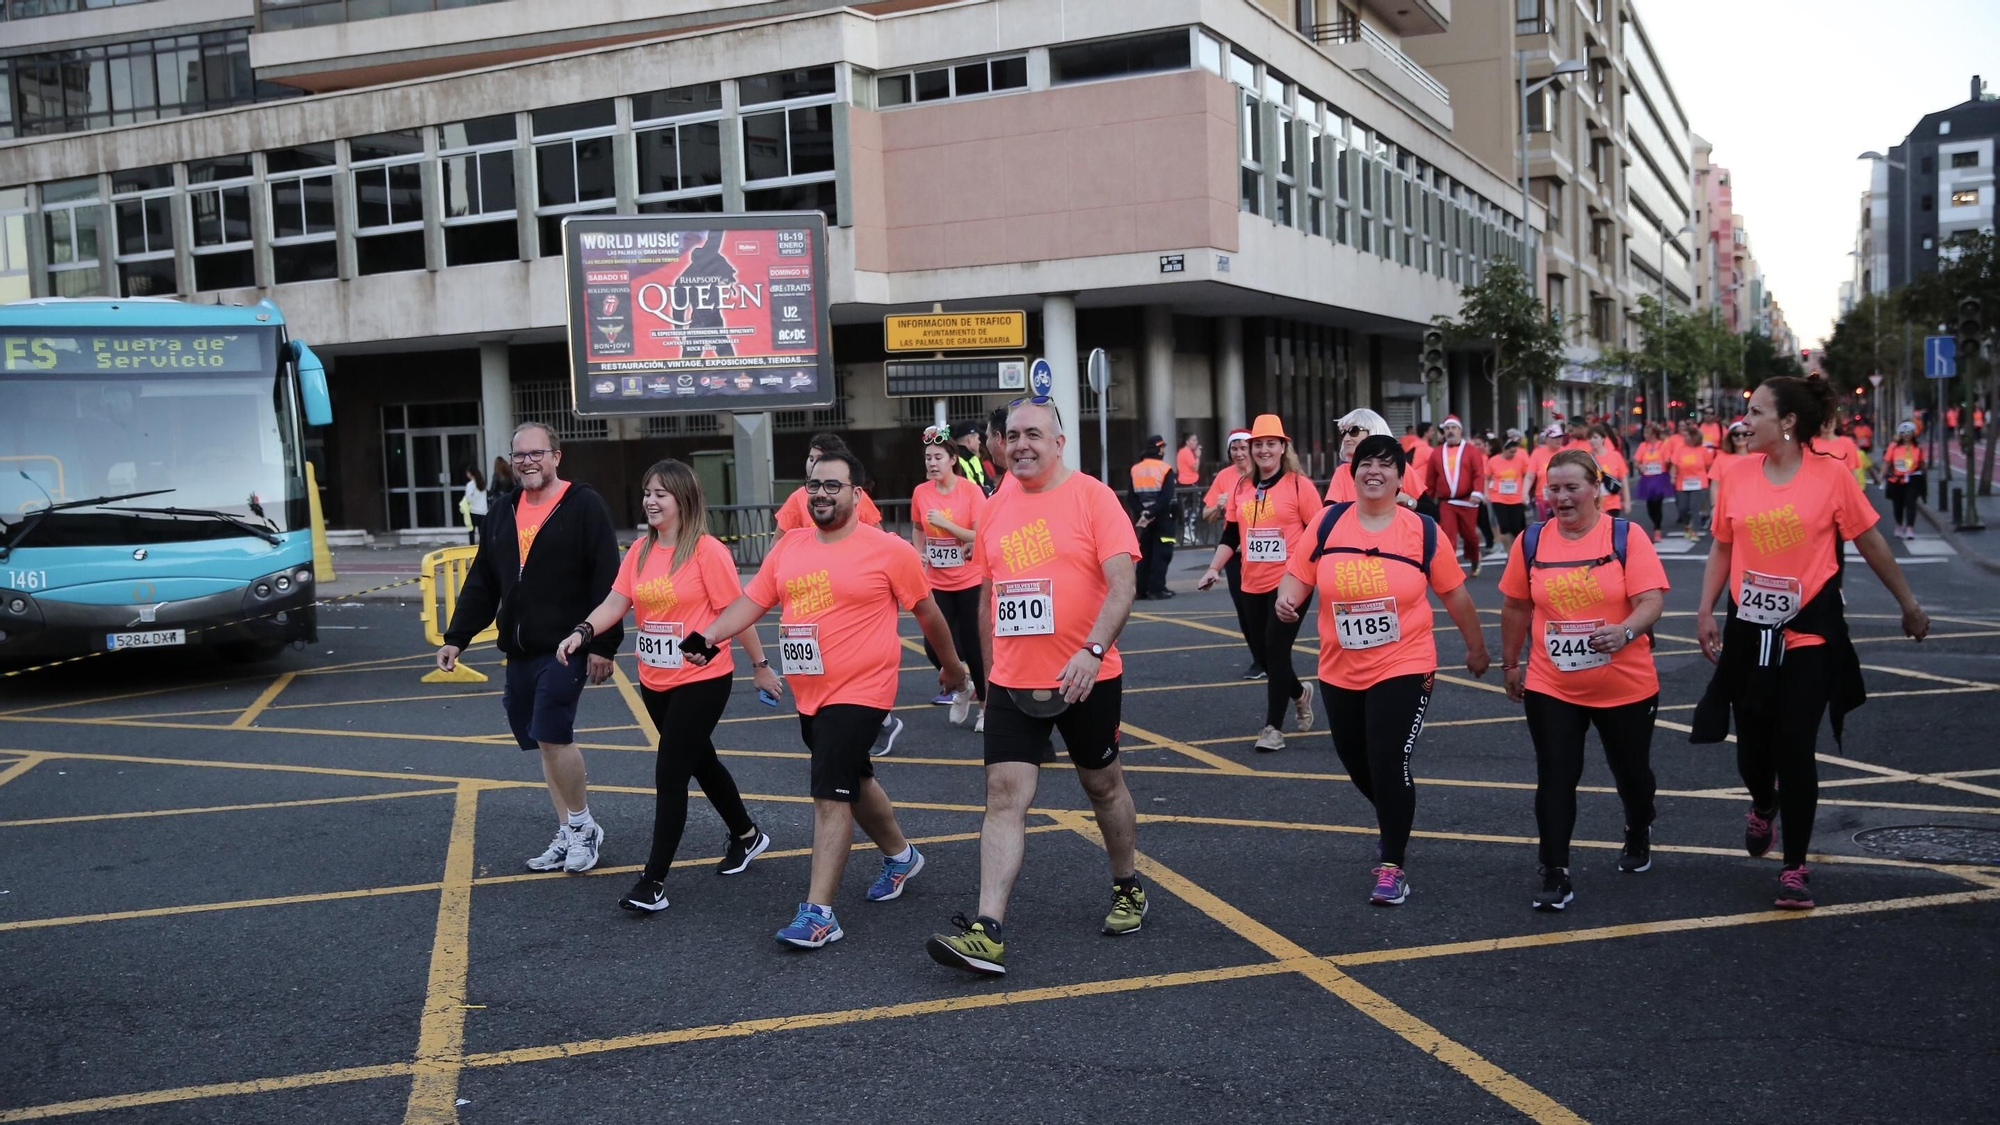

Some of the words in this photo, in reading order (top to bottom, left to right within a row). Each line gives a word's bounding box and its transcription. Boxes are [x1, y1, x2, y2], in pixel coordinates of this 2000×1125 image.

[584, 234, 632, 249] WORLD
[638, 232, 679, 248] MUSIC
[778, 233, 803, 241] 18-19
[638, 283, 762, 325] QUEEN
[784, 306, 798, 318] U2
[898, 318, 957, 328] INFORMACION
[961, 318, 972, 326] DE
[976, 317, 1011, 326] TRAFICO
[93, 338, 182, 351] Fuera
[193, 336, 224, 350] de
[4, 338, 57, 370] FS
[96, 352, 224, 369] Servicio
[706, 358, 766, 366] EXPOSICIONES,
[1000, 519, 1046, 548] SANS
[930, 549, 958, 559] 3478
[1249, 540, 1280, 552] 4872
[1335, 558, 1382, 574] SANS
[9, 571, 47, 588] 1461
[786, 570, 828, 593] SANS
[1742, 589, 1790, 612] 2453
[999, 599, 1042, 620] 6810
[1342, 616, 1390, 636] 1185
[117, 634, 148, 647] 5284
[640, 636, 672, 655] 6811
[784, 643, 813, 660] 6809
[1404, 696, 1428, 754] STRONG
